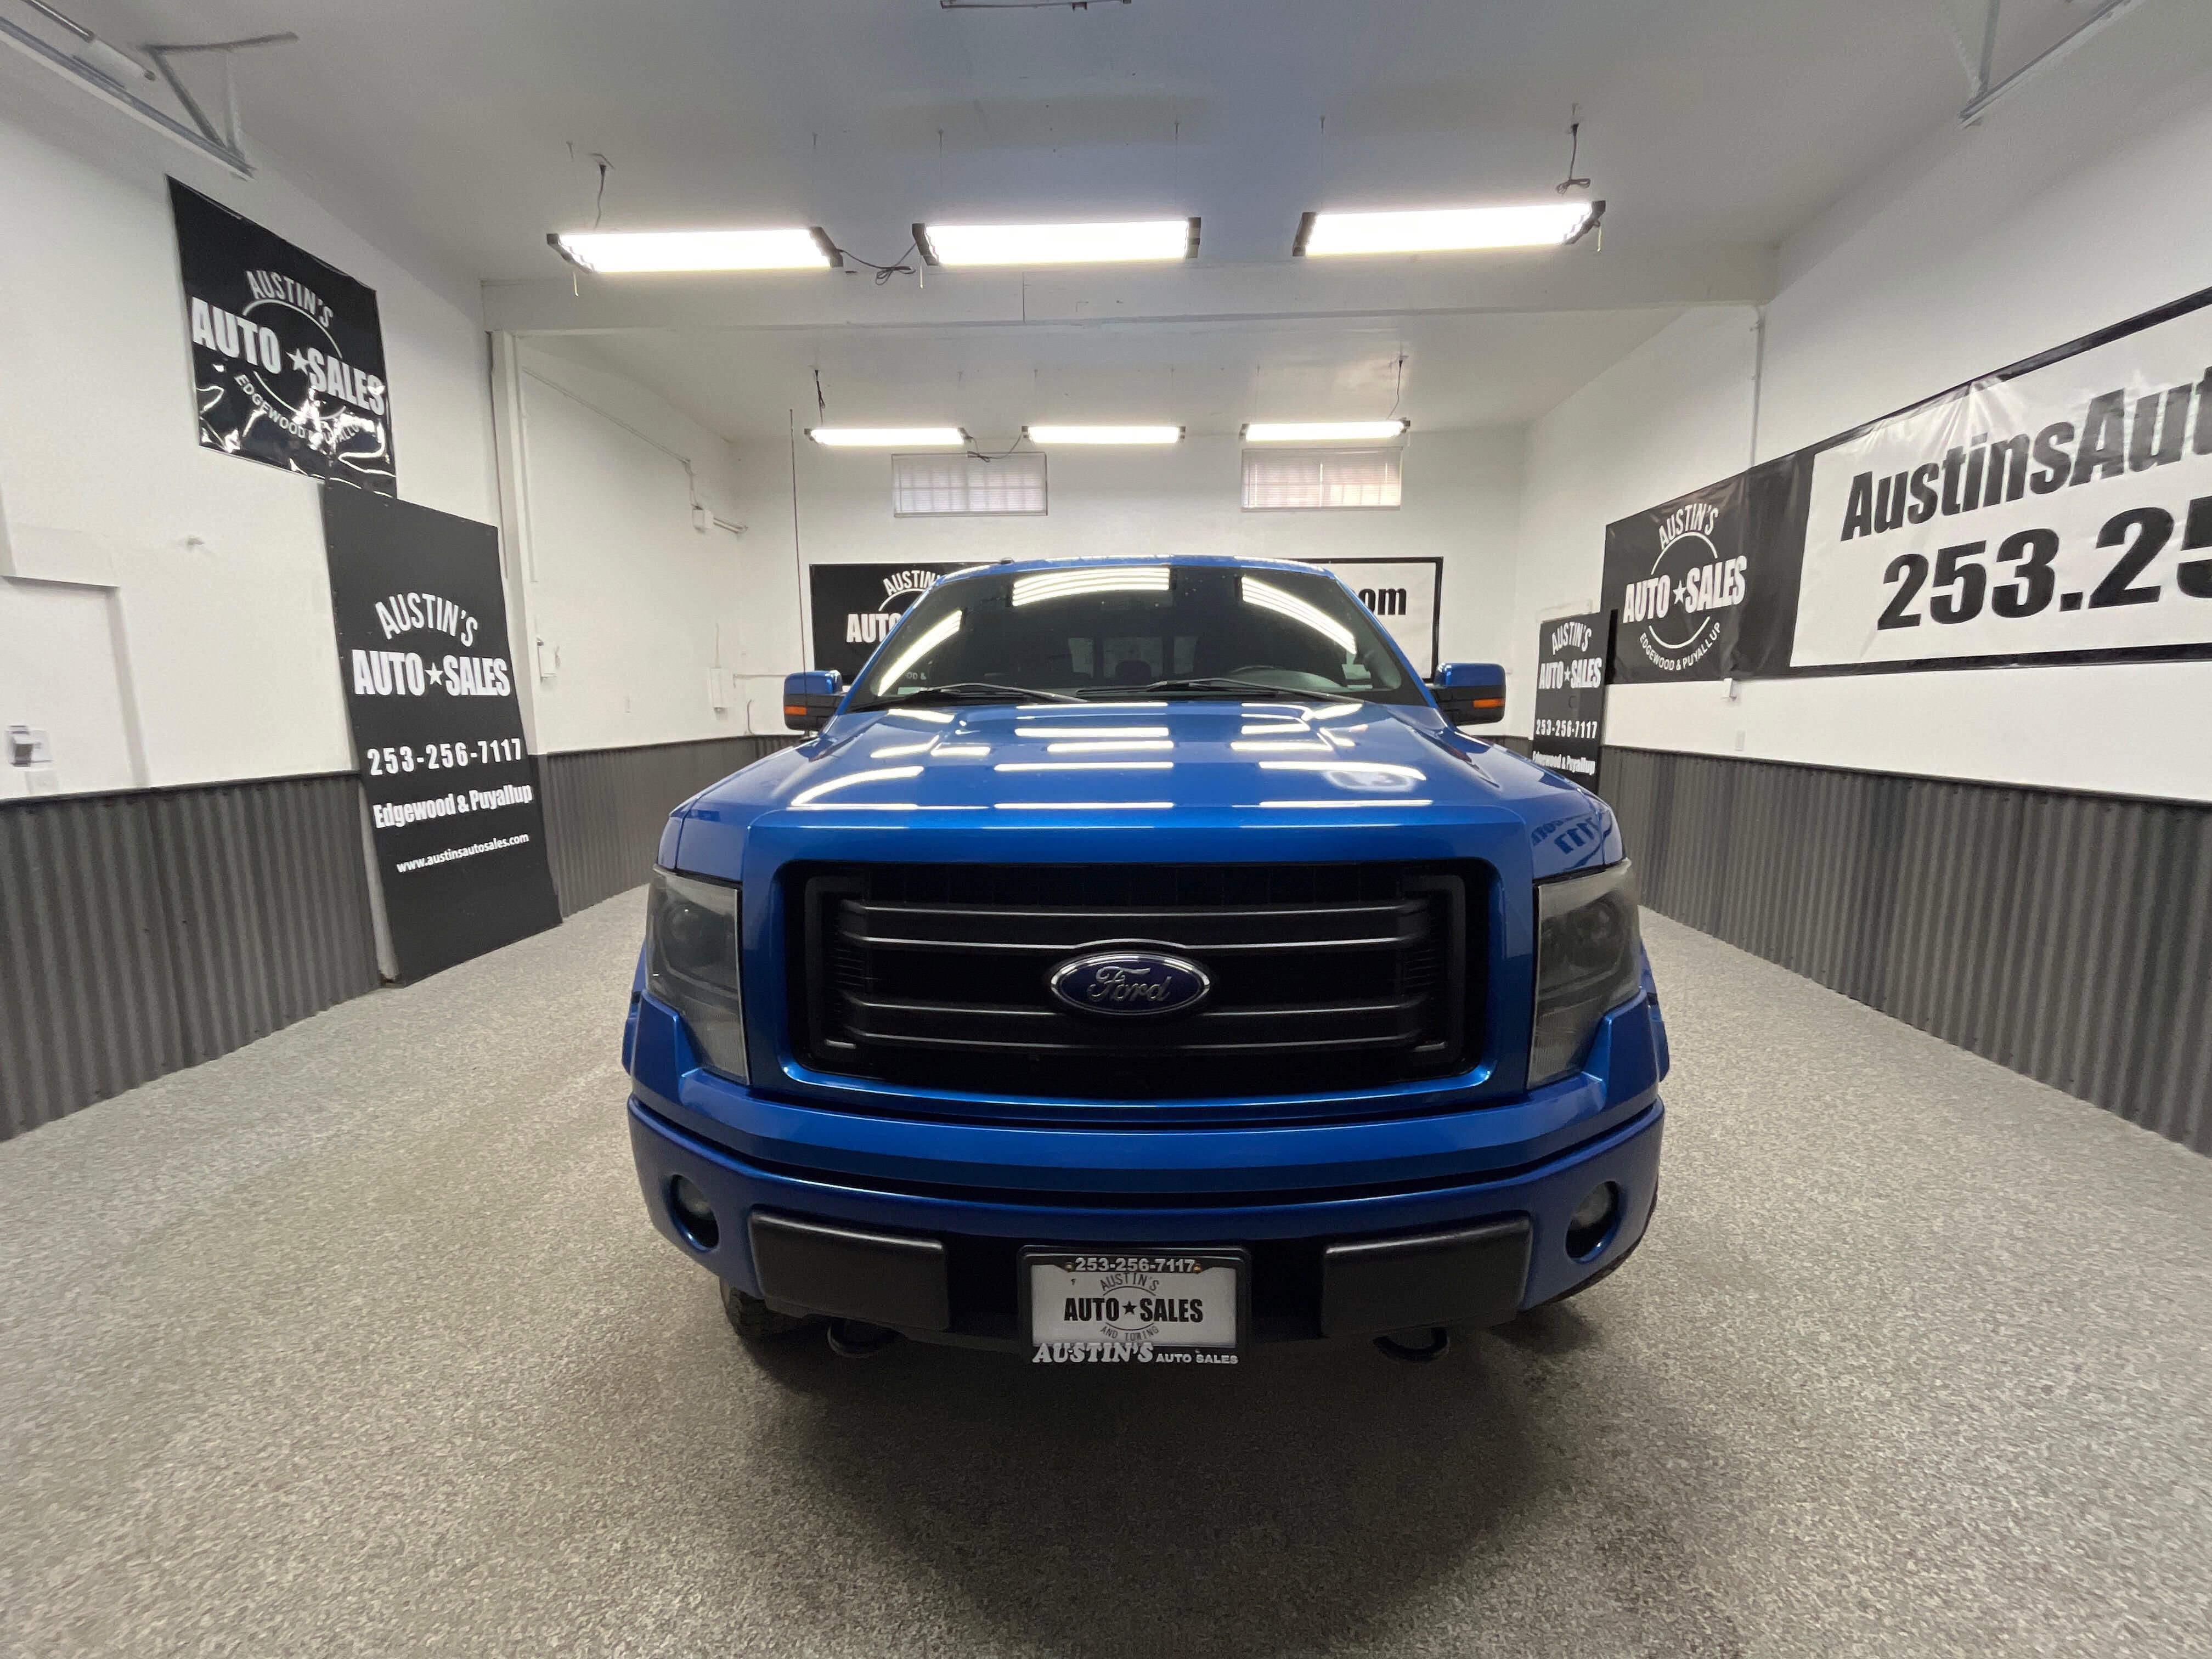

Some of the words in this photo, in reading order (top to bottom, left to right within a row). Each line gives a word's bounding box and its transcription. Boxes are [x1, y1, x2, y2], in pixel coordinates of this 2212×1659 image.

[246, 270, 334, 328] AUSTIN'S
[191, 297, 281, 374] AUTO
[307, 347, 385, 415] SALES
[1658, 503, 1719, 550] AUSTIN'S
[1623, 575, 1671, 623] AUTO
[1685, 555, 1747, 613] SALES
[375, 592, 478, 647] AUSTIN'S
[1551, 622, 1592, 655] AUSTIN'S
[1639, 633, 1675, 671] EDGEWOOD
[1676, 659, 1681, 671] &
[1683, 622, 1721, 669] PUYALLUP
[352, 650, 425, 696] AUTO
[443, 654, 511, 696] SALES
[1538, 661, 1564, 689] AUTO
[1570, 658, 1602, 689] SALES
[1536, 719, 1598, 739] 253-256-7117
[367, 738, 521, 776] 253-256-7117
[373, 793, 456, 828] Edgewood
[457, 794, 470, 814] &
[469, 784, 533, 810] Puyallup
[396, 833, 530, 873] www.austinsautosales.com
[1086, 966, 1172, 1002] Ford
[1075, 1257, 1195, 1273] 253-256-7117
[1100, 1272, 1159, 1291] AUSTIN'S
[1064, 1297, 1120, 1322] AUTO
[1140, 1298, 1203, 1323] SALES
[1100, 1326, 1119, 1339] AND
[1125, 1325, 1159, 1341] TOWING
[1032, 1342, 1154, 1364] AUSTIN'S
[1156, 1353, 1192, 1363] AUTO
[1195, 1353, 1238, 1364] SALES
